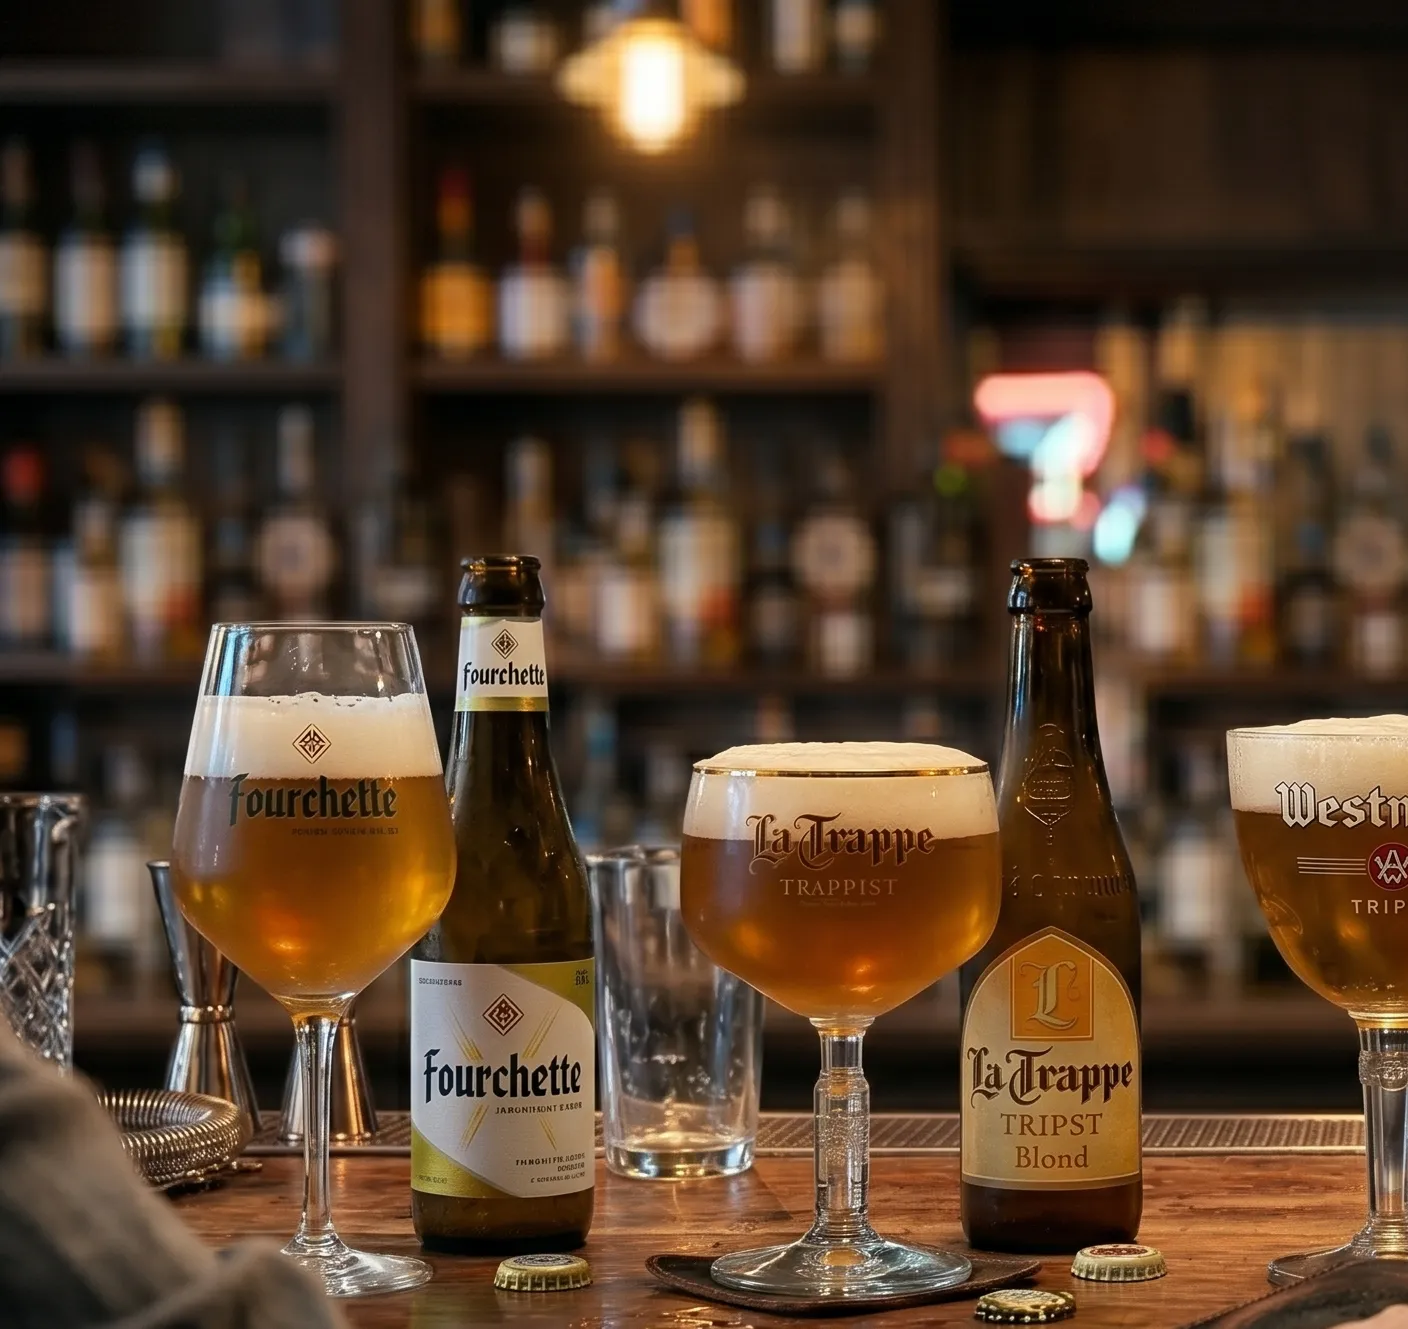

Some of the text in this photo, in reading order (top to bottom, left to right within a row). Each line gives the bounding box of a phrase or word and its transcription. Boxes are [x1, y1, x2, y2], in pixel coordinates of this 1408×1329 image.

[746, 812, 936, 875] La Trappe
[779, 878, 899, 897] TRAPPIST
[966, 1045, 1134, 1109] La Trappe
[1000, 1113, 1103, 1137] TRIPST
[1014, 1145, 1090, 1170] Blond
